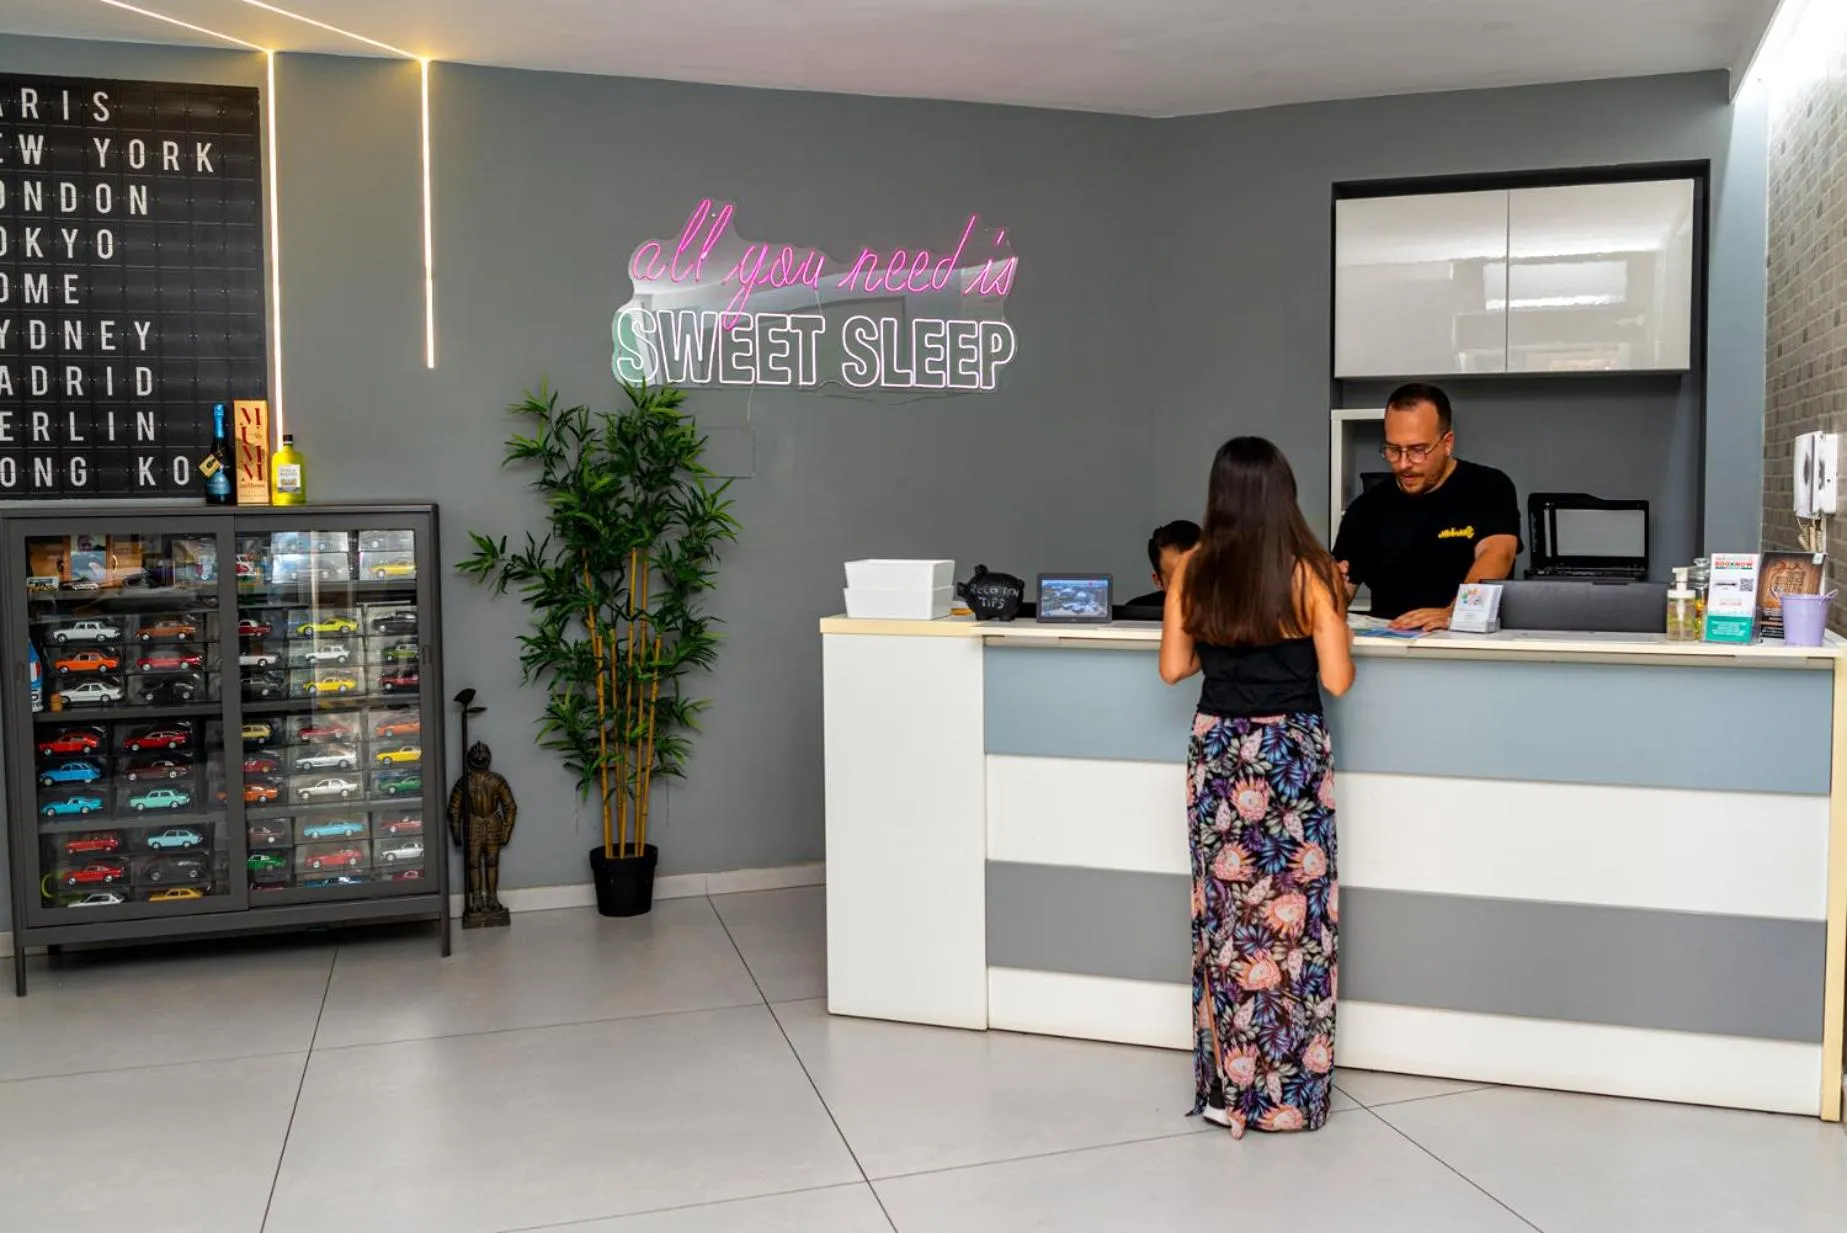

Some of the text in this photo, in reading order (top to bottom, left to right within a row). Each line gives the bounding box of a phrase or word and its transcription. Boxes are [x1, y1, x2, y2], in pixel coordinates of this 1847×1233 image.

[0, 87, 110, 122] RIS
[0, 132, 214, 174] W YORK
[630, 198, 1020, 331] all you need is
[0, 318, 152, 352] YDNEY
[616, 307, 1016, 391] SWEET SLEEP
[0, 364, 154, 397] ADRID
[0, 410, 156, 443] ERLIN
[0, 455, 88, 489] ONG
[137, 455, 191, 487] KO
